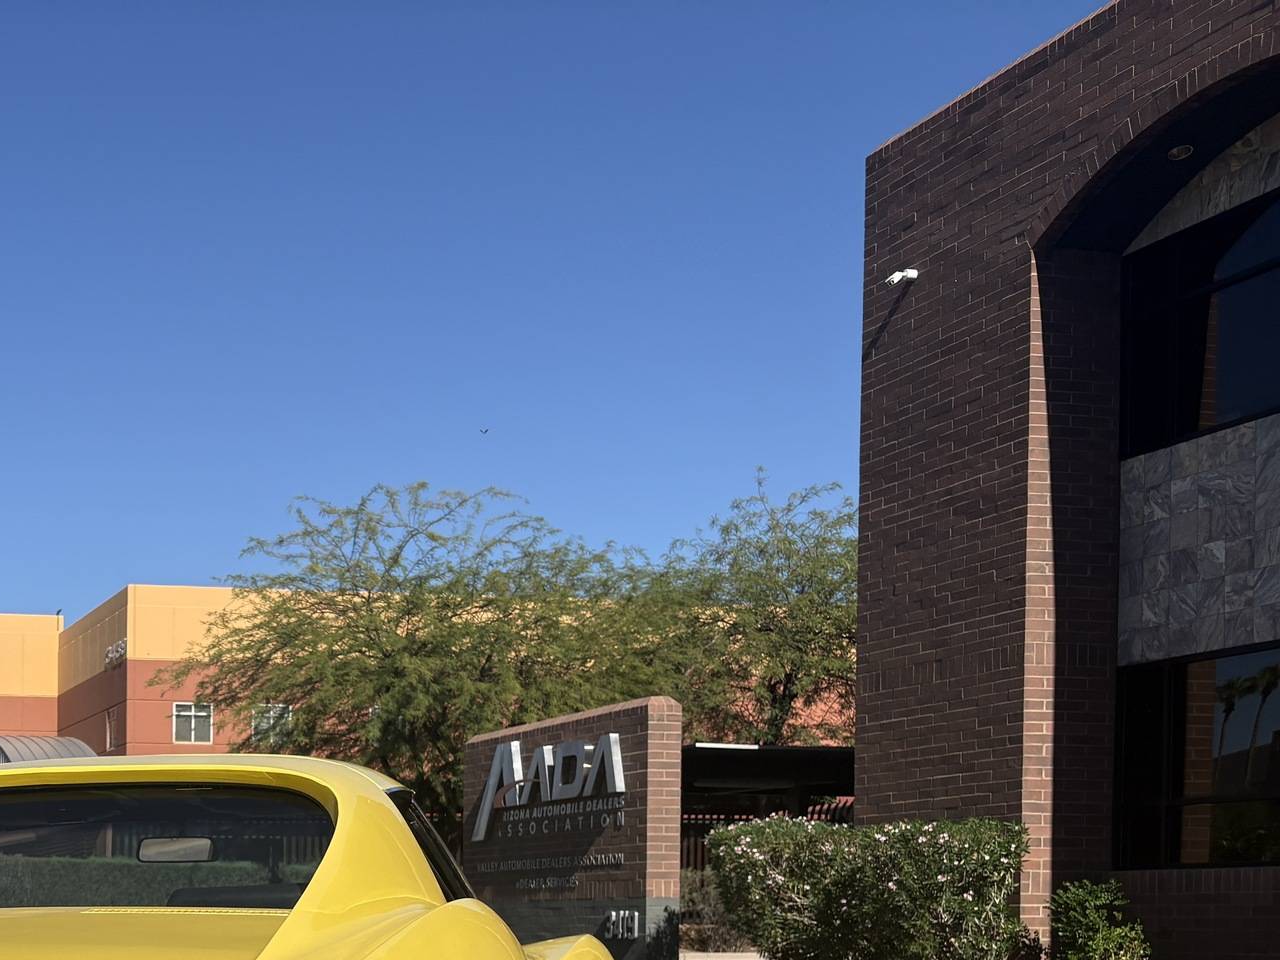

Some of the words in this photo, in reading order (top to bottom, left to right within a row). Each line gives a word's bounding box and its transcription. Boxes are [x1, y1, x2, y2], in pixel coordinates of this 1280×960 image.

[472, 733, 626, 842] AADA
[502, 808, 530, 821] RIZONA
[532, 802, 583, 819] AUTOMOBILE
[585, 795, 625, 811] DEALERS
[498, 810, 625, 838] SSOCIATION
[499, 859, 541, 873] AUTOMOBILE
[574, 852, 625, 867] ASSOCIATION
